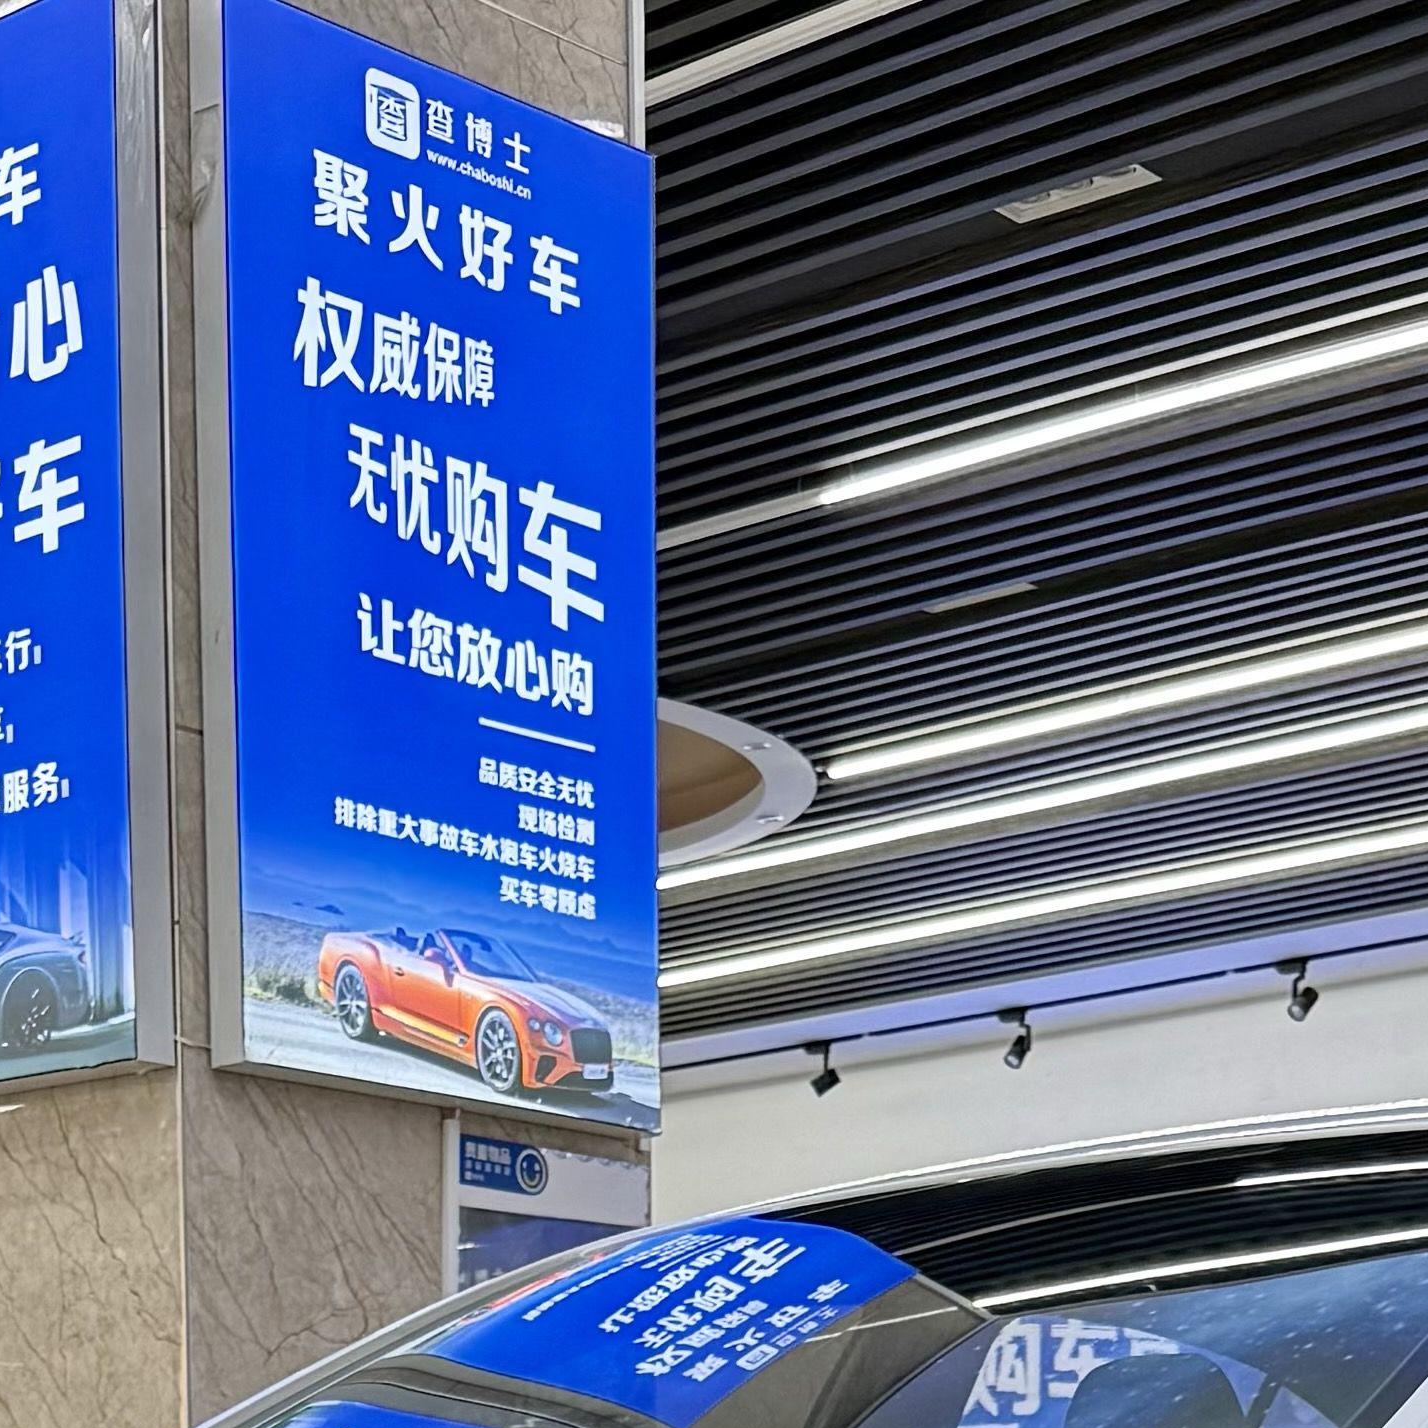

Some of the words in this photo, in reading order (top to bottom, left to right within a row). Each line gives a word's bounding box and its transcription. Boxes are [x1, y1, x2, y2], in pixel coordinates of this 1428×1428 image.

[426, 99, 532, 174] 查博士
[426, 149, 532, 200] www.chaboshi.cn
[313, 148, 581, 315] 聚火好车
[293, 276, 495, 408] 权威保障
[348, 423, 604, 631] 无忧购车
[357, 592, 594, 716] 让您放心购
[478, 756, 595, 809] 品质安全无忧
[334, 796, 596, 883] 排除重大事故车水泡车火烧车
[518, 804, 595, 847] 现场检测
[499, 875, 596, 920] 买车零顾虑
